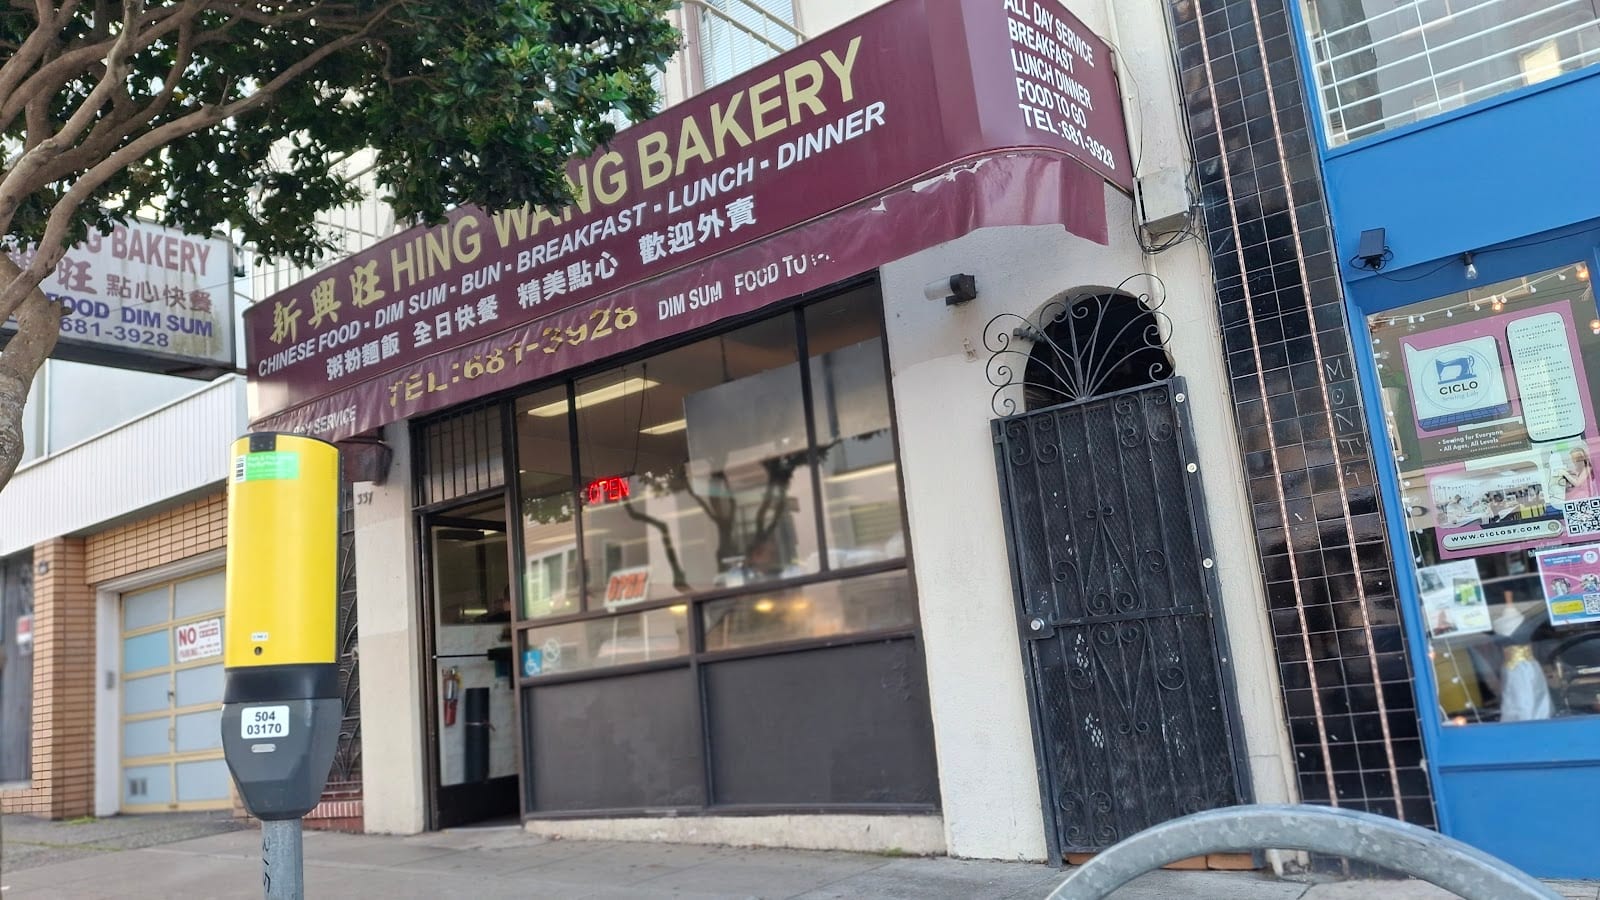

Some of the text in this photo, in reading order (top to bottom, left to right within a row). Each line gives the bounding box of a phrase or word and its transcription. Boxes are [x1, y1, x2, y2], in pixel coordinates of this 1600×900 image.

[1004, 0, 1094, 68] ALL DAY SERVICE
[1008, 17, 1073, 74] BREAKFAST
[1011, 48, 1093, 111] LUNCH DINNER
[1016, 77, 1087, 129] FOOD TO GO
[391, 216, 481, 292] HING
[637, 36, 862, 190] BAKERY
[113, 224, 211, 277] BAKERY
[258, 101, 886, 377] CHINESE FOOD DIM SUM BUN BREAKFAST LUNCH DINNER
[413, 293, 499, 348] 全日快餐
[516, 251, 619, 309] 精美點心
[638, 195, 757, 265] 歡迎外賣
[658, 292, 686, 321] DIM
[689, 281, 723, 310] SUM
[60, 317, 169, 348] 681-3928
[121, 306, 161, 330] DIM
[166, 314, 213, 337] SUM
[1439, 380, 1479, 396] CICLO
[313, 404, 357, 435] SERVICE
[588, 477, 630, 505] OPEN
[179, 627, 197, 647] NO
[247, 723, 282, 735] 03170
[255, 711, 276, 722] 504
